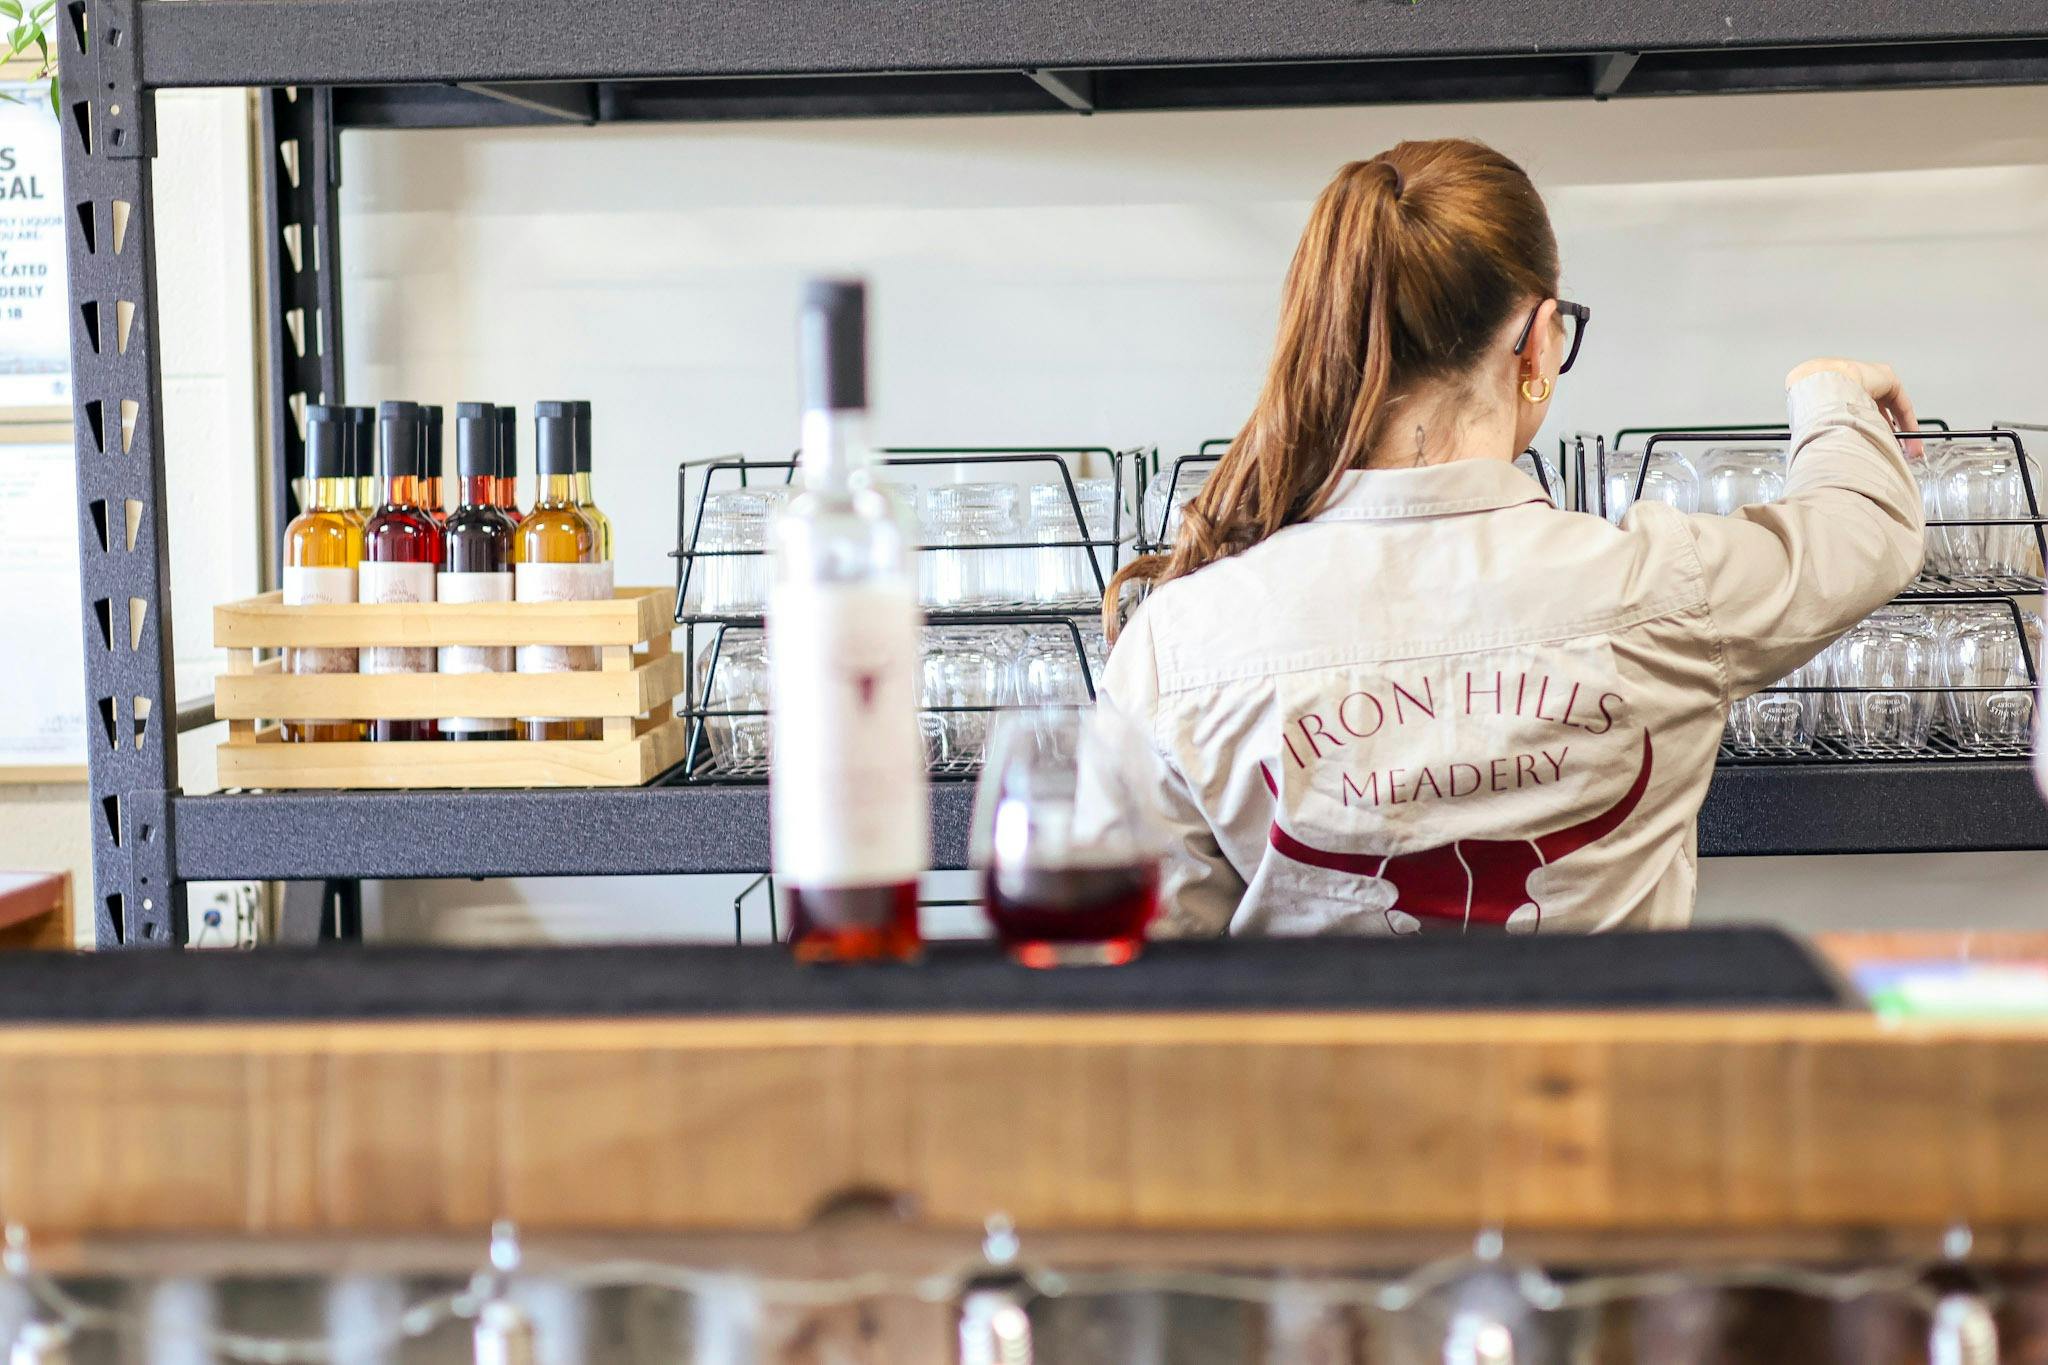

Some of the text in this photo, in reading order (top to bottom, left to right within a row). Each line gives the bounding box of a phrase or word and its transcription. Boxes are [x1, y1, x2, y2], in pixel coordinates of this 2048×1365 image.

[1282, 671, 1623, 768] IRON HILLS
[1342, 746, 1569, 806] MEADERY
